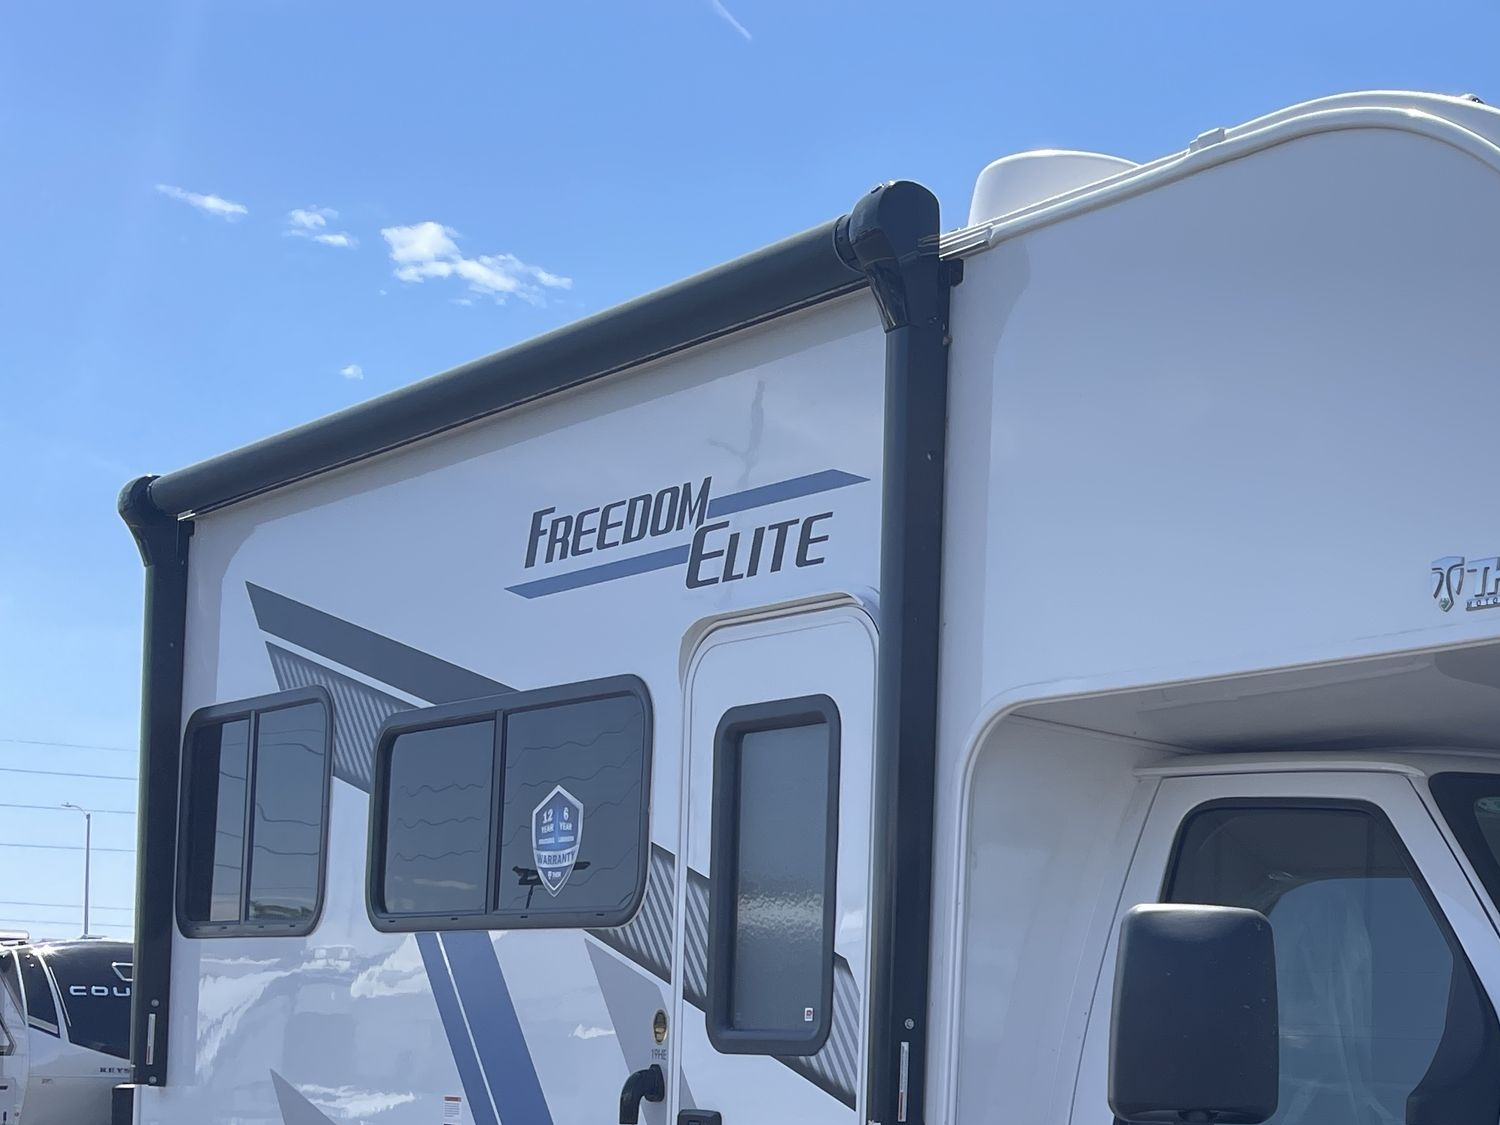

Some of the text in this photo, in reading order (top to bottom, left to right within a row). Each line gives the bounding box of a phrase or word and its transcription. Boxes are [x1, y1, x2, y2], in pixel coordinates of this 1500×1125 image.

[524, 476, 712, 569] FREEDOM
[685, 511, 834, 589] ELITE
[542, 808, 554, 824] 12
[563, 806, 570, 821] 6
[541, 824, 554, 834] YEAR
[559, 821, 573, 831] YEAR
[536, 851, 577, 866] WARRANTY
